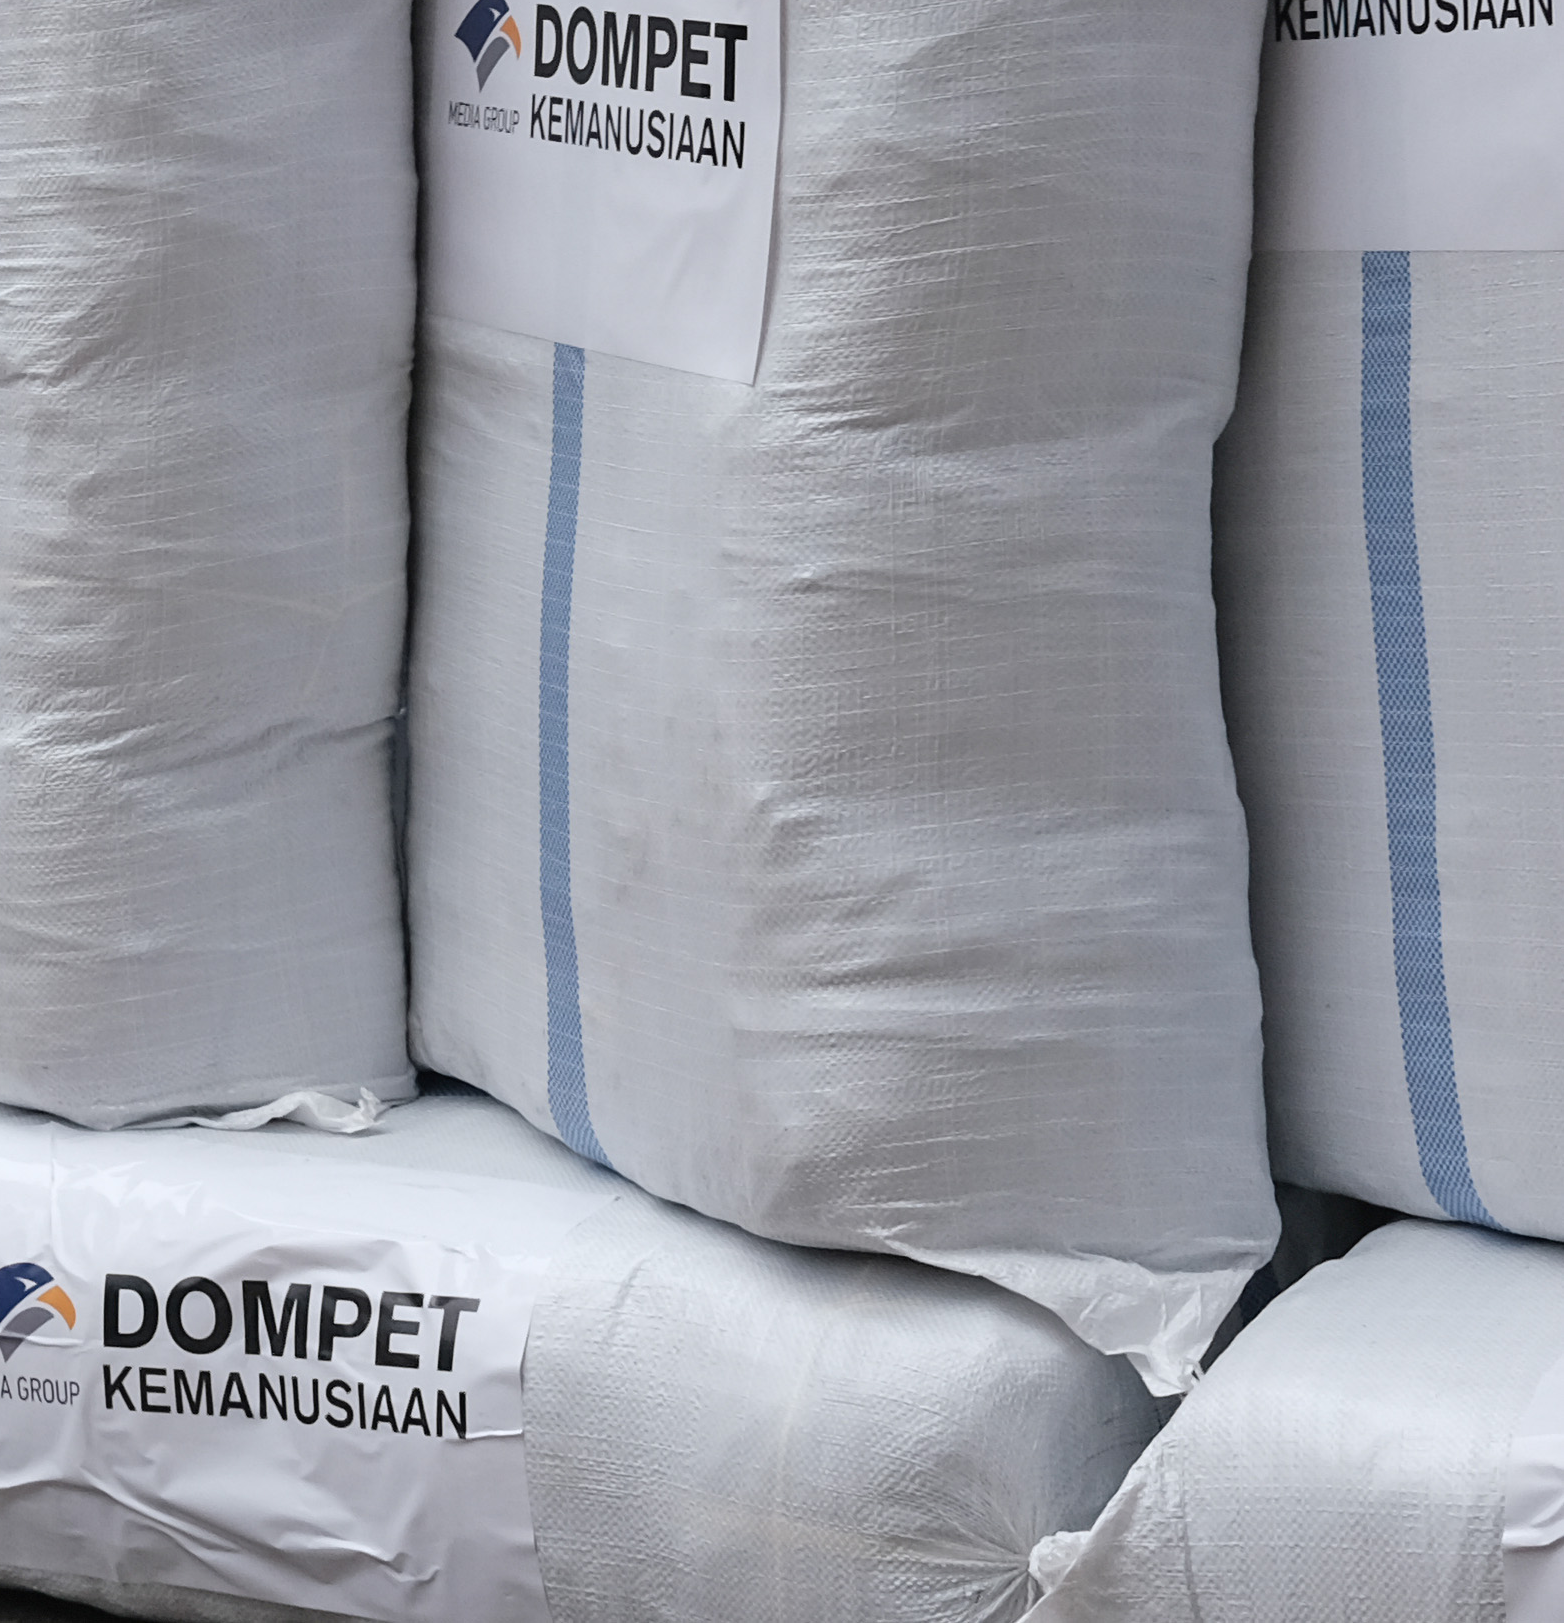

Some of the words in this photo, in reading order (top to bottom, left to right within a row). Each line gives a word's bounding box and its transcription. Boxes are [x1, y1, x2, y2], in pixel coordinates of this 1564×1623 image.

[534, 3, 748, 102] DOMPET
[448, 101, 481, 129] MEDIA
[484, 106, 520, 135] GROUP
[530, 94, 746, 169] KEMANUSIAAN
[103, 1274, 481, 1372] DOMPET
[17, 1376, 80, 1405] GROUP
[103, 1365, 467, 1439] KEMANUSIAAN
